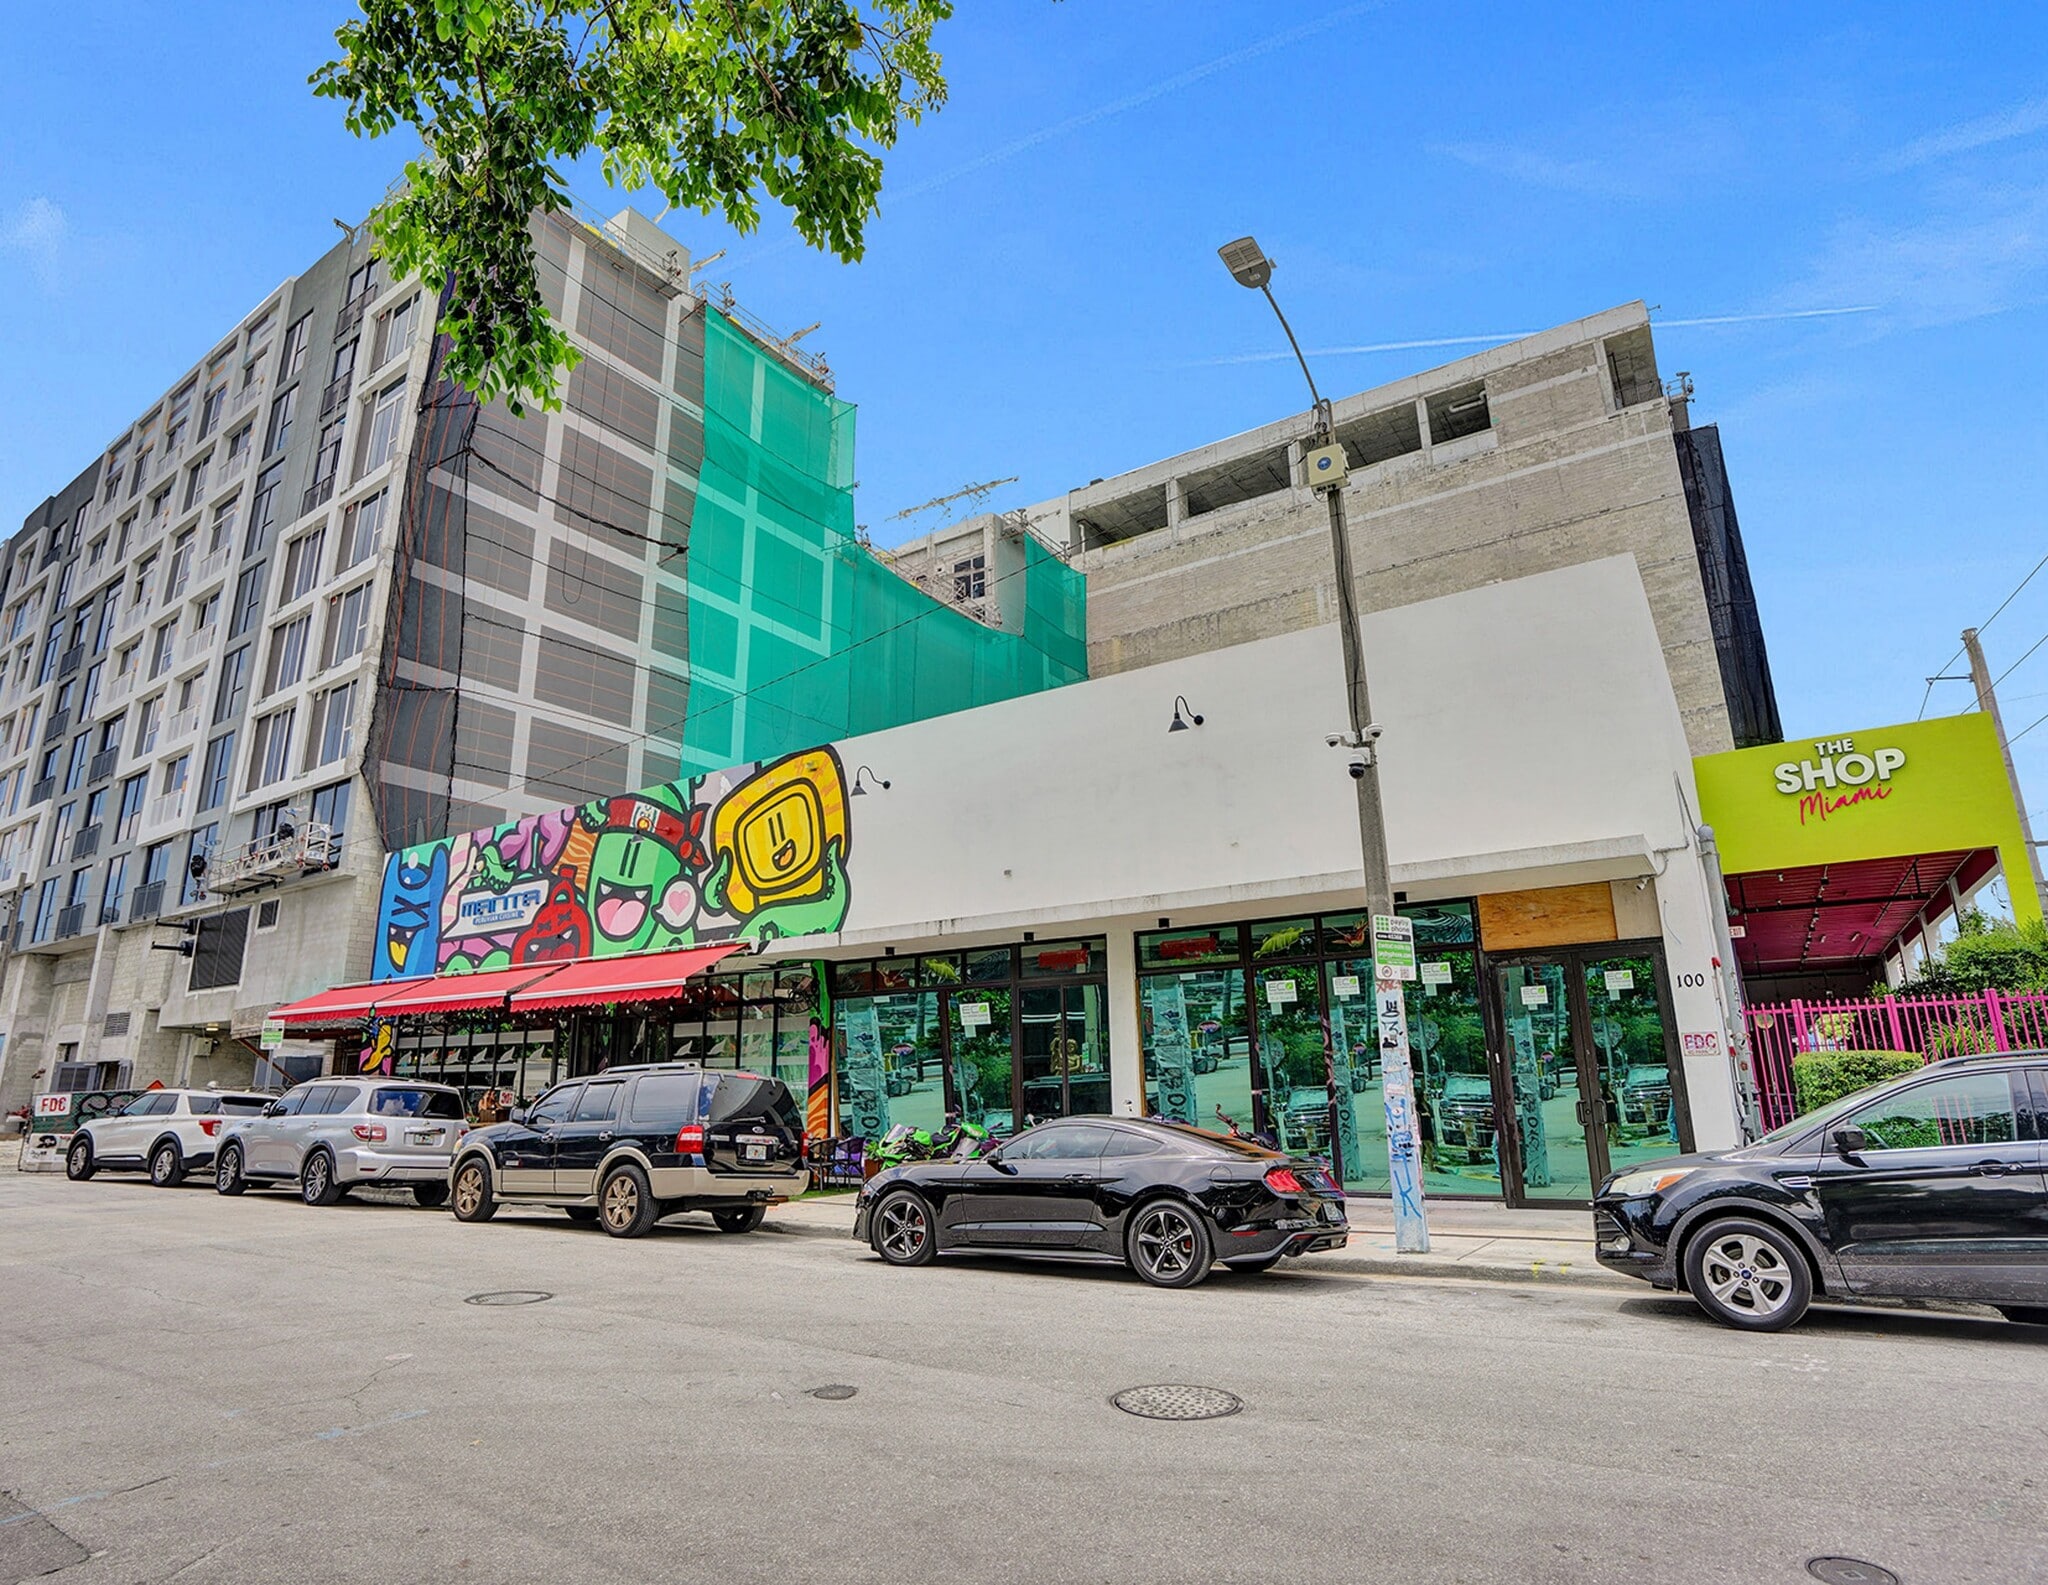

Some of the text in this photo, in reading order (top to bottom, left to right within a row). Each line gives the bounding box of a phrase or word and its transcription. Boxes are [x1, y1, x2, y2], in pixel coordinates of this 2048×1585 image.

[1815, 738, 1853, 756] THE
[1774, 747, 1906, 794] SHOP
[1799, 783, 1893, 826] Miami
[1677, 974, 1705, 988] 100
[1684, 1034, 1716, 1050] FDC
[41, 1097, 67, 1112] FDC
